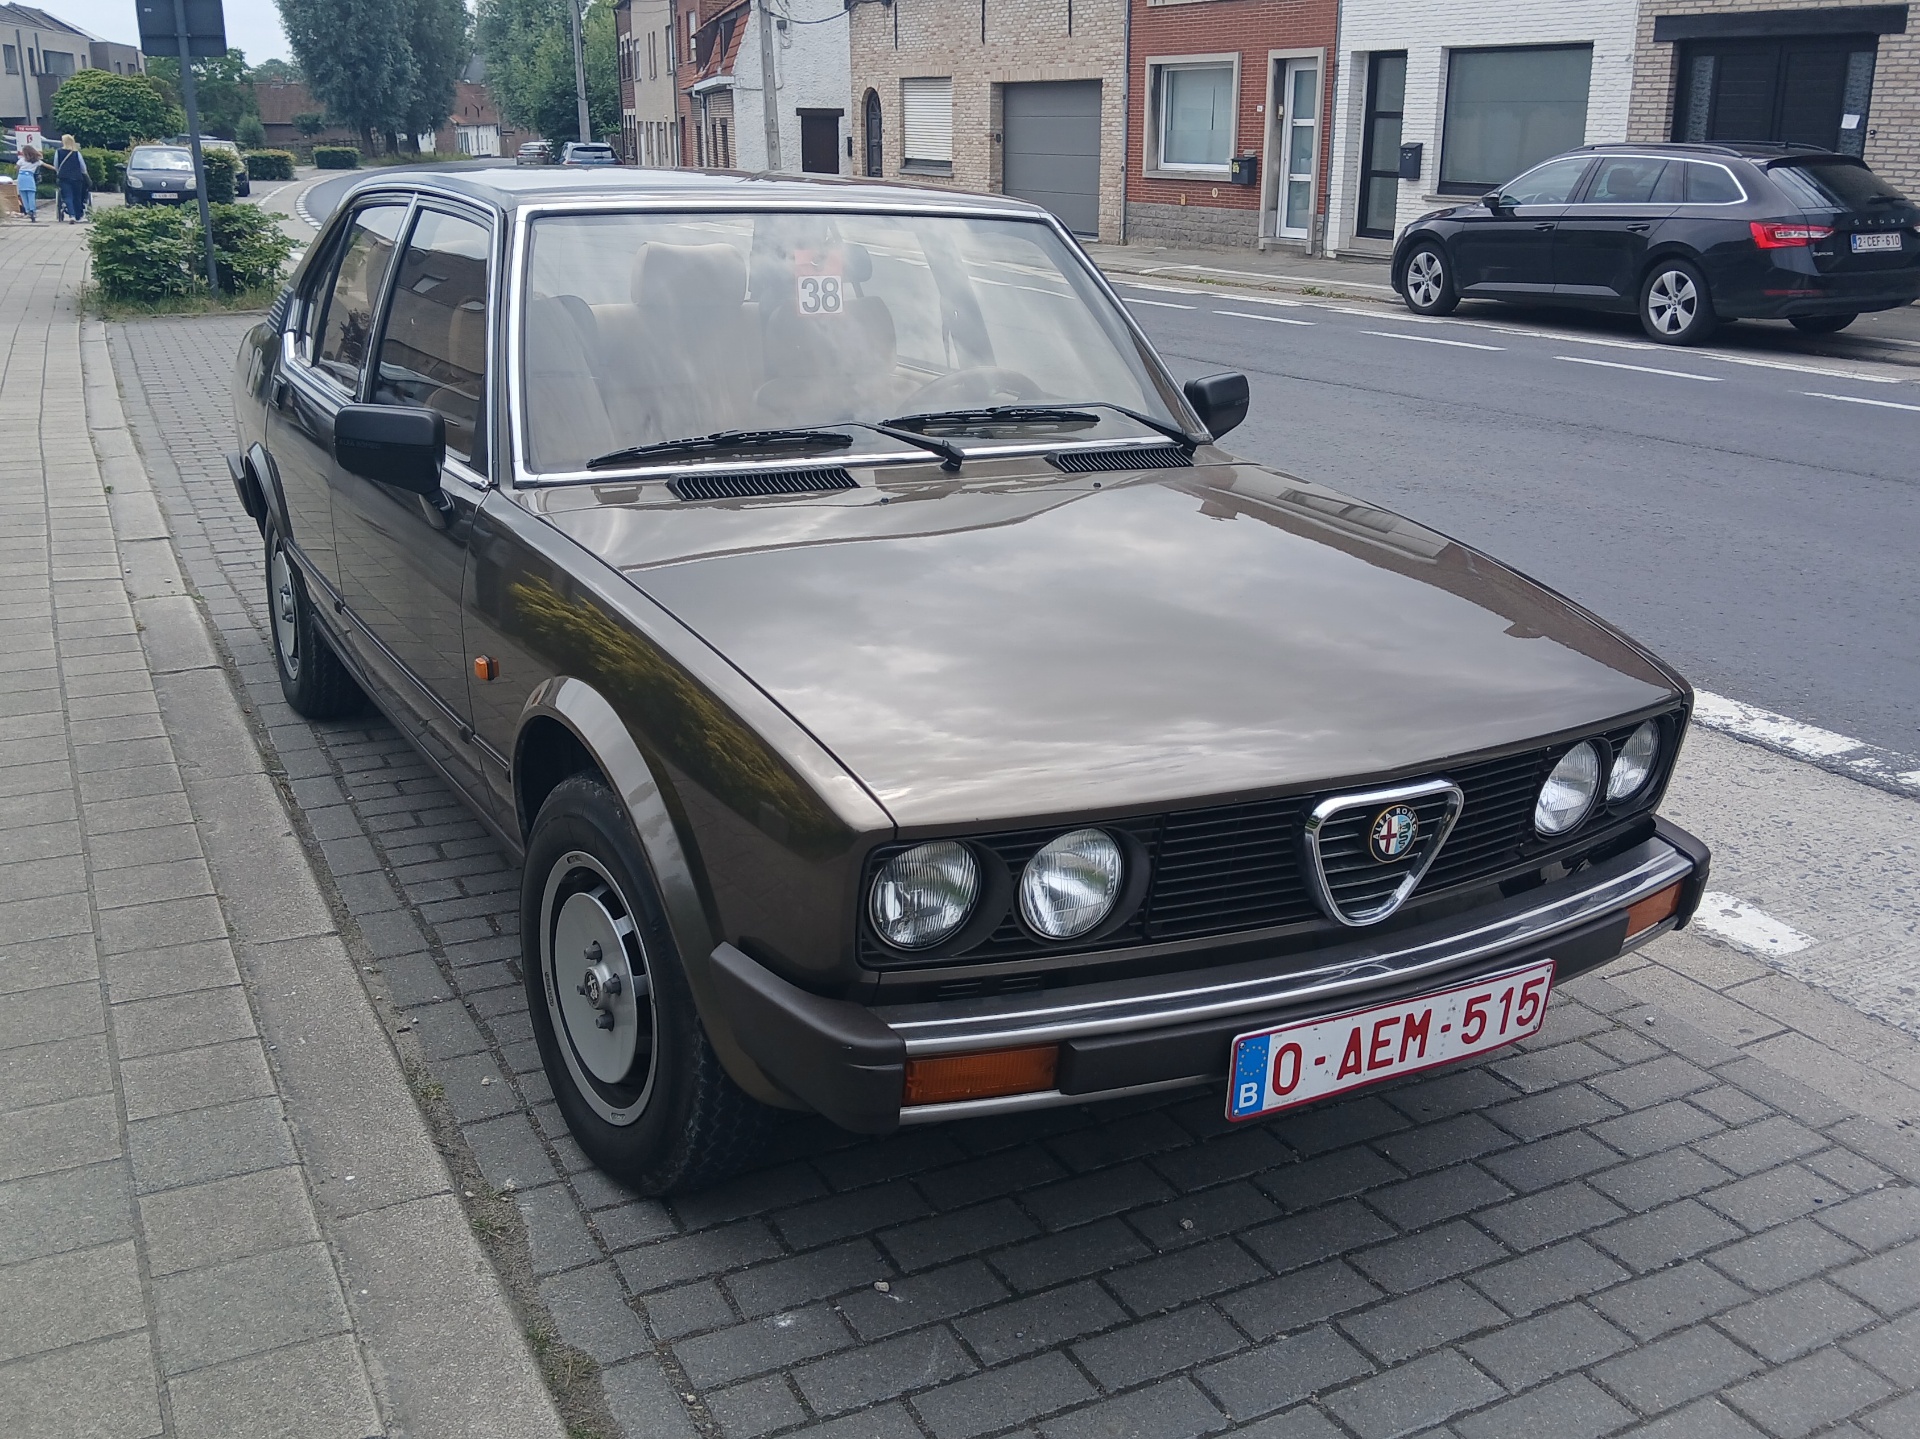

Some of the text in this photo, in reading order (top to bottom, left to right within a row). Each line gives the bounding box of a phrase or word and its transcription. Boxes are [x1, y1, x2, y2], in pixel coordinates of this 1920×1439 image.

[801, 277, 840, 313] 38
[1373, 807, 1417, 840] ALFA ROMEO
[1238, 1082, 1258, 1109] B
